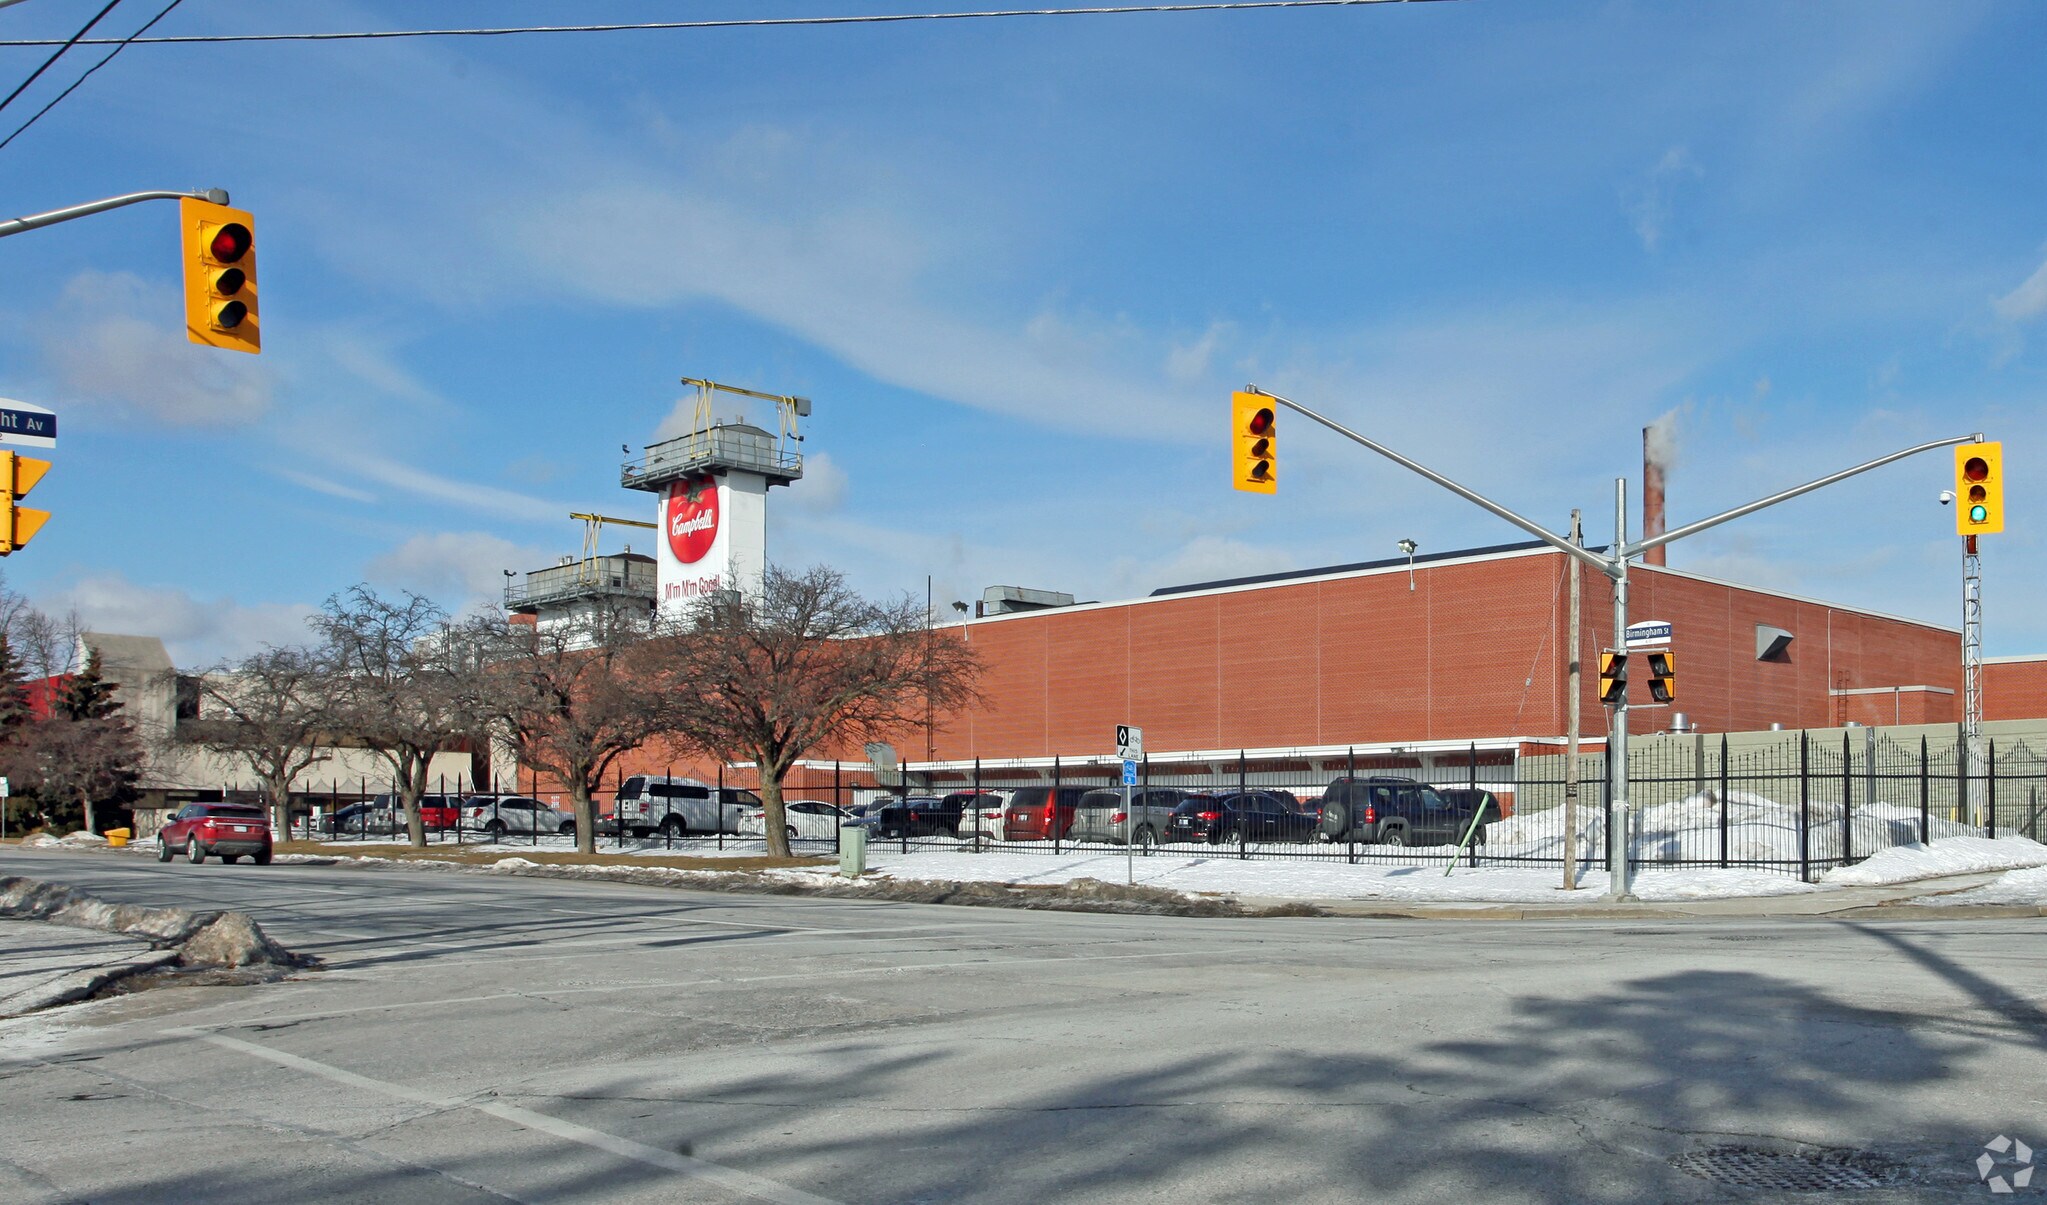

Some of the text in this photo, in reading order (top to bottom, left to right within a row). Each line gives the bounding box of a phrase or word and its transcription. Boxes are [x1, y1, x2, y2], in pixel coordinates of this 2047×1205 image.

[26, 417, 44, 431] Av
[1626, 627, 1669, 638] Birmingham St
